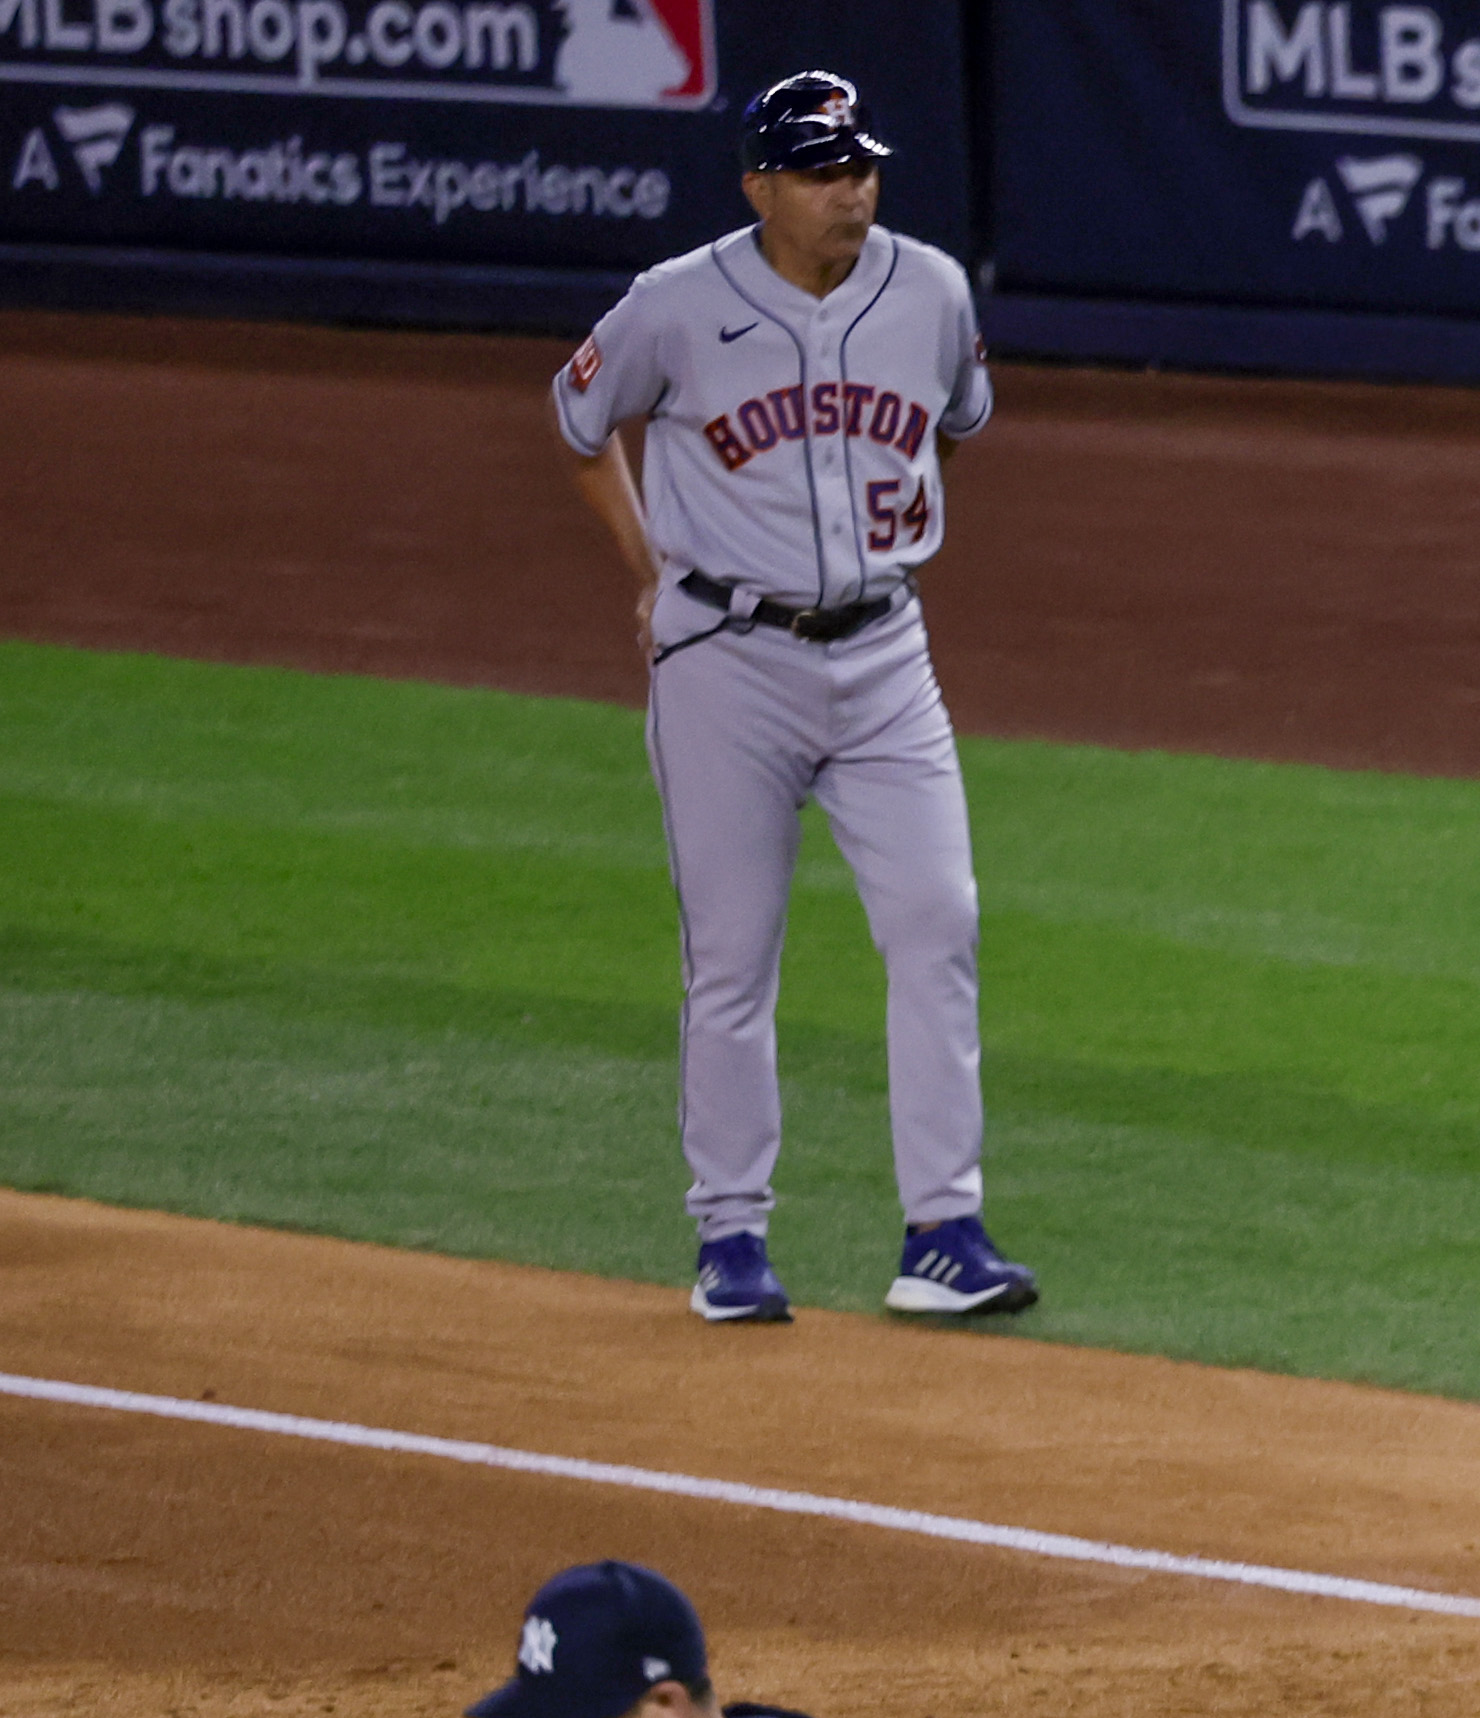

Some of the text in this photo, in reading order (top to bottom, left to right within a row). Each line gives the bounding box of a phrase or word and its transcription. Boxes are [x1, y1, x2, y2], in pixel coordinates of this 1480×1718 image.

[14, 124, 671, 224] A Fanatics Experience
[1292, 178, 1342, 244] A
[703, 383, 930, 472] HOUSTON
[866, 474, 932, 553] 54
